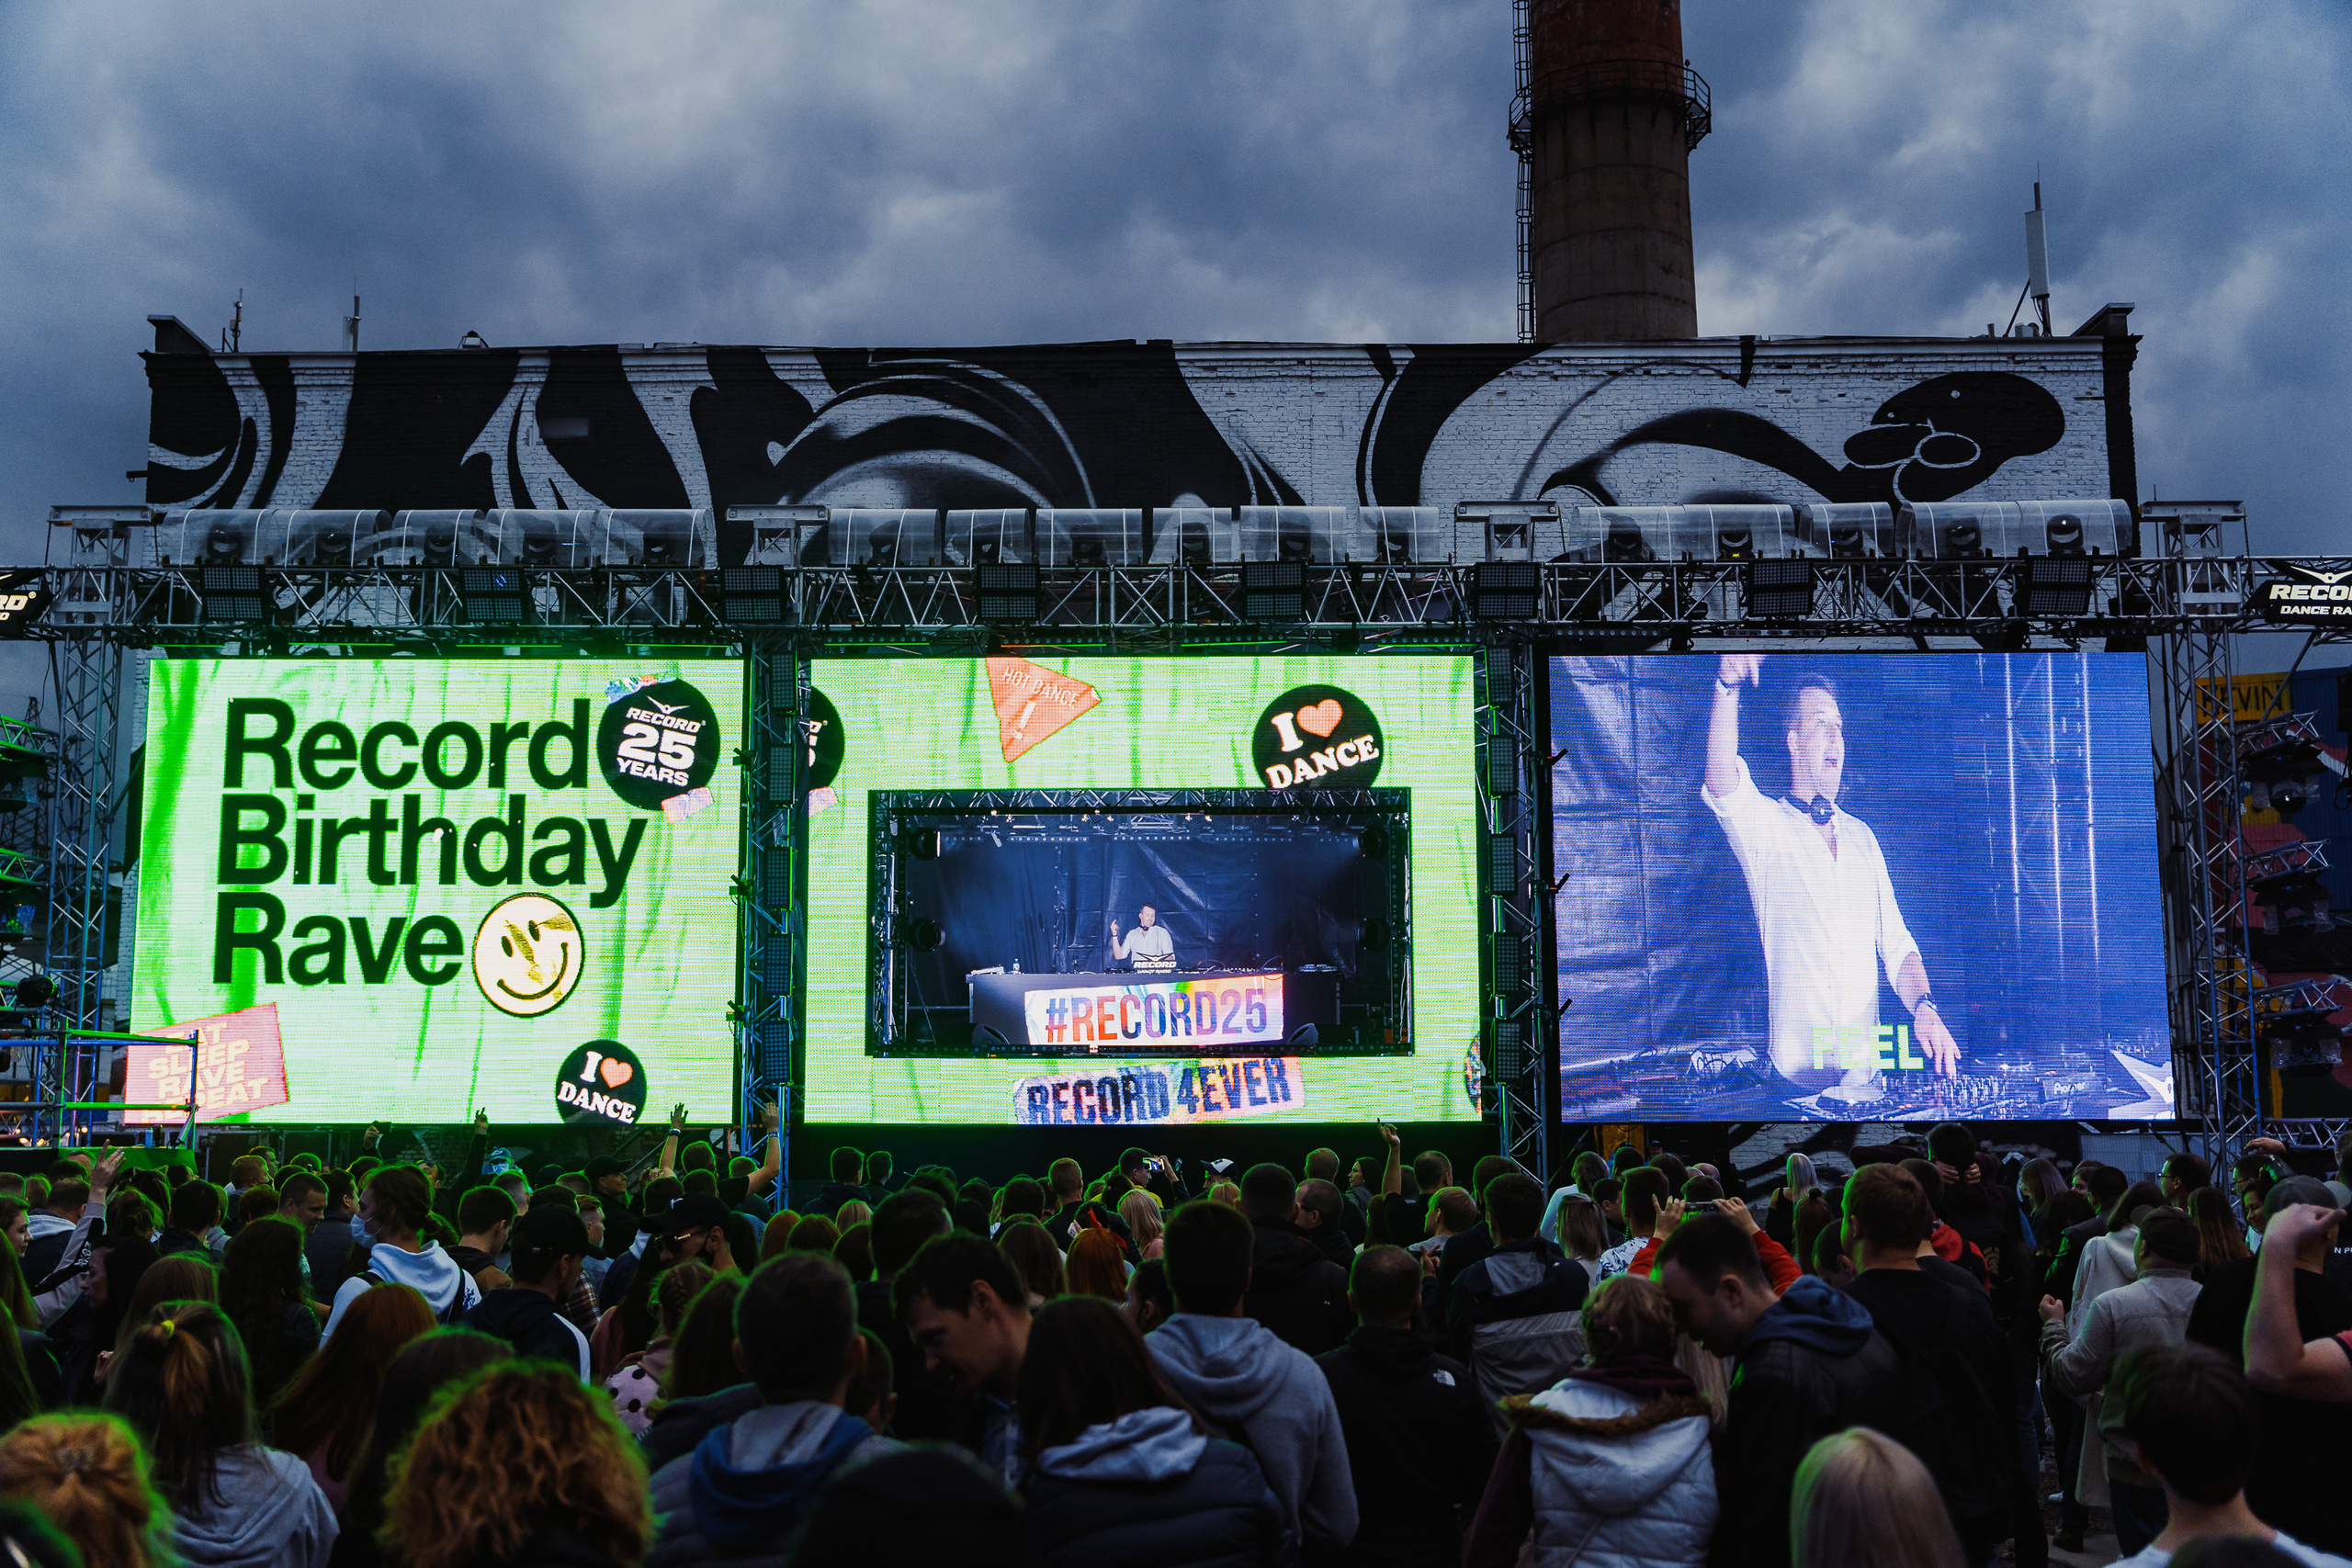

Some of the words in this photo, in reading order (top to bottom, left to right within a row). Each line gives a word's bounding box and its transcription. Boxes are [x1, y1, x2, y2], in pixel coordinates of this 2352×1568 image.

[2269, 584, 2352, 601] RECO
[2280, 605, 2331, 615] DANCE
[1001, 666, 1032, 689] HOT
[1033, 679, 1080, 709] DANCE
[626, 706, 702, 734] RECORD
[1271, 712, 1304, 752] I
[224, 698, 589, 790] Record
[617, 722, 697, 770] 25
[1265, 734, 1380, 789] DANCE
[616, 757, 690, 787] YEARS
[217, 794, 648, 908] Birthday
[213, 891, 464, 985] Rave
[1133, 960, 1177, 969] RECORD
[1045, 987, 1268, 1043] #RECORD25
[579, 1050, 603, 1083] I
[1812, 1024, 1924, 1070] FEEL
[158, 1061, 247, 1100] RAVE
[557, 1080, 637, 1124] DANCE
[1026, 1070, 1170, 1124] RECORD
[1176, 1057, 1292, 1115] 4EVER
